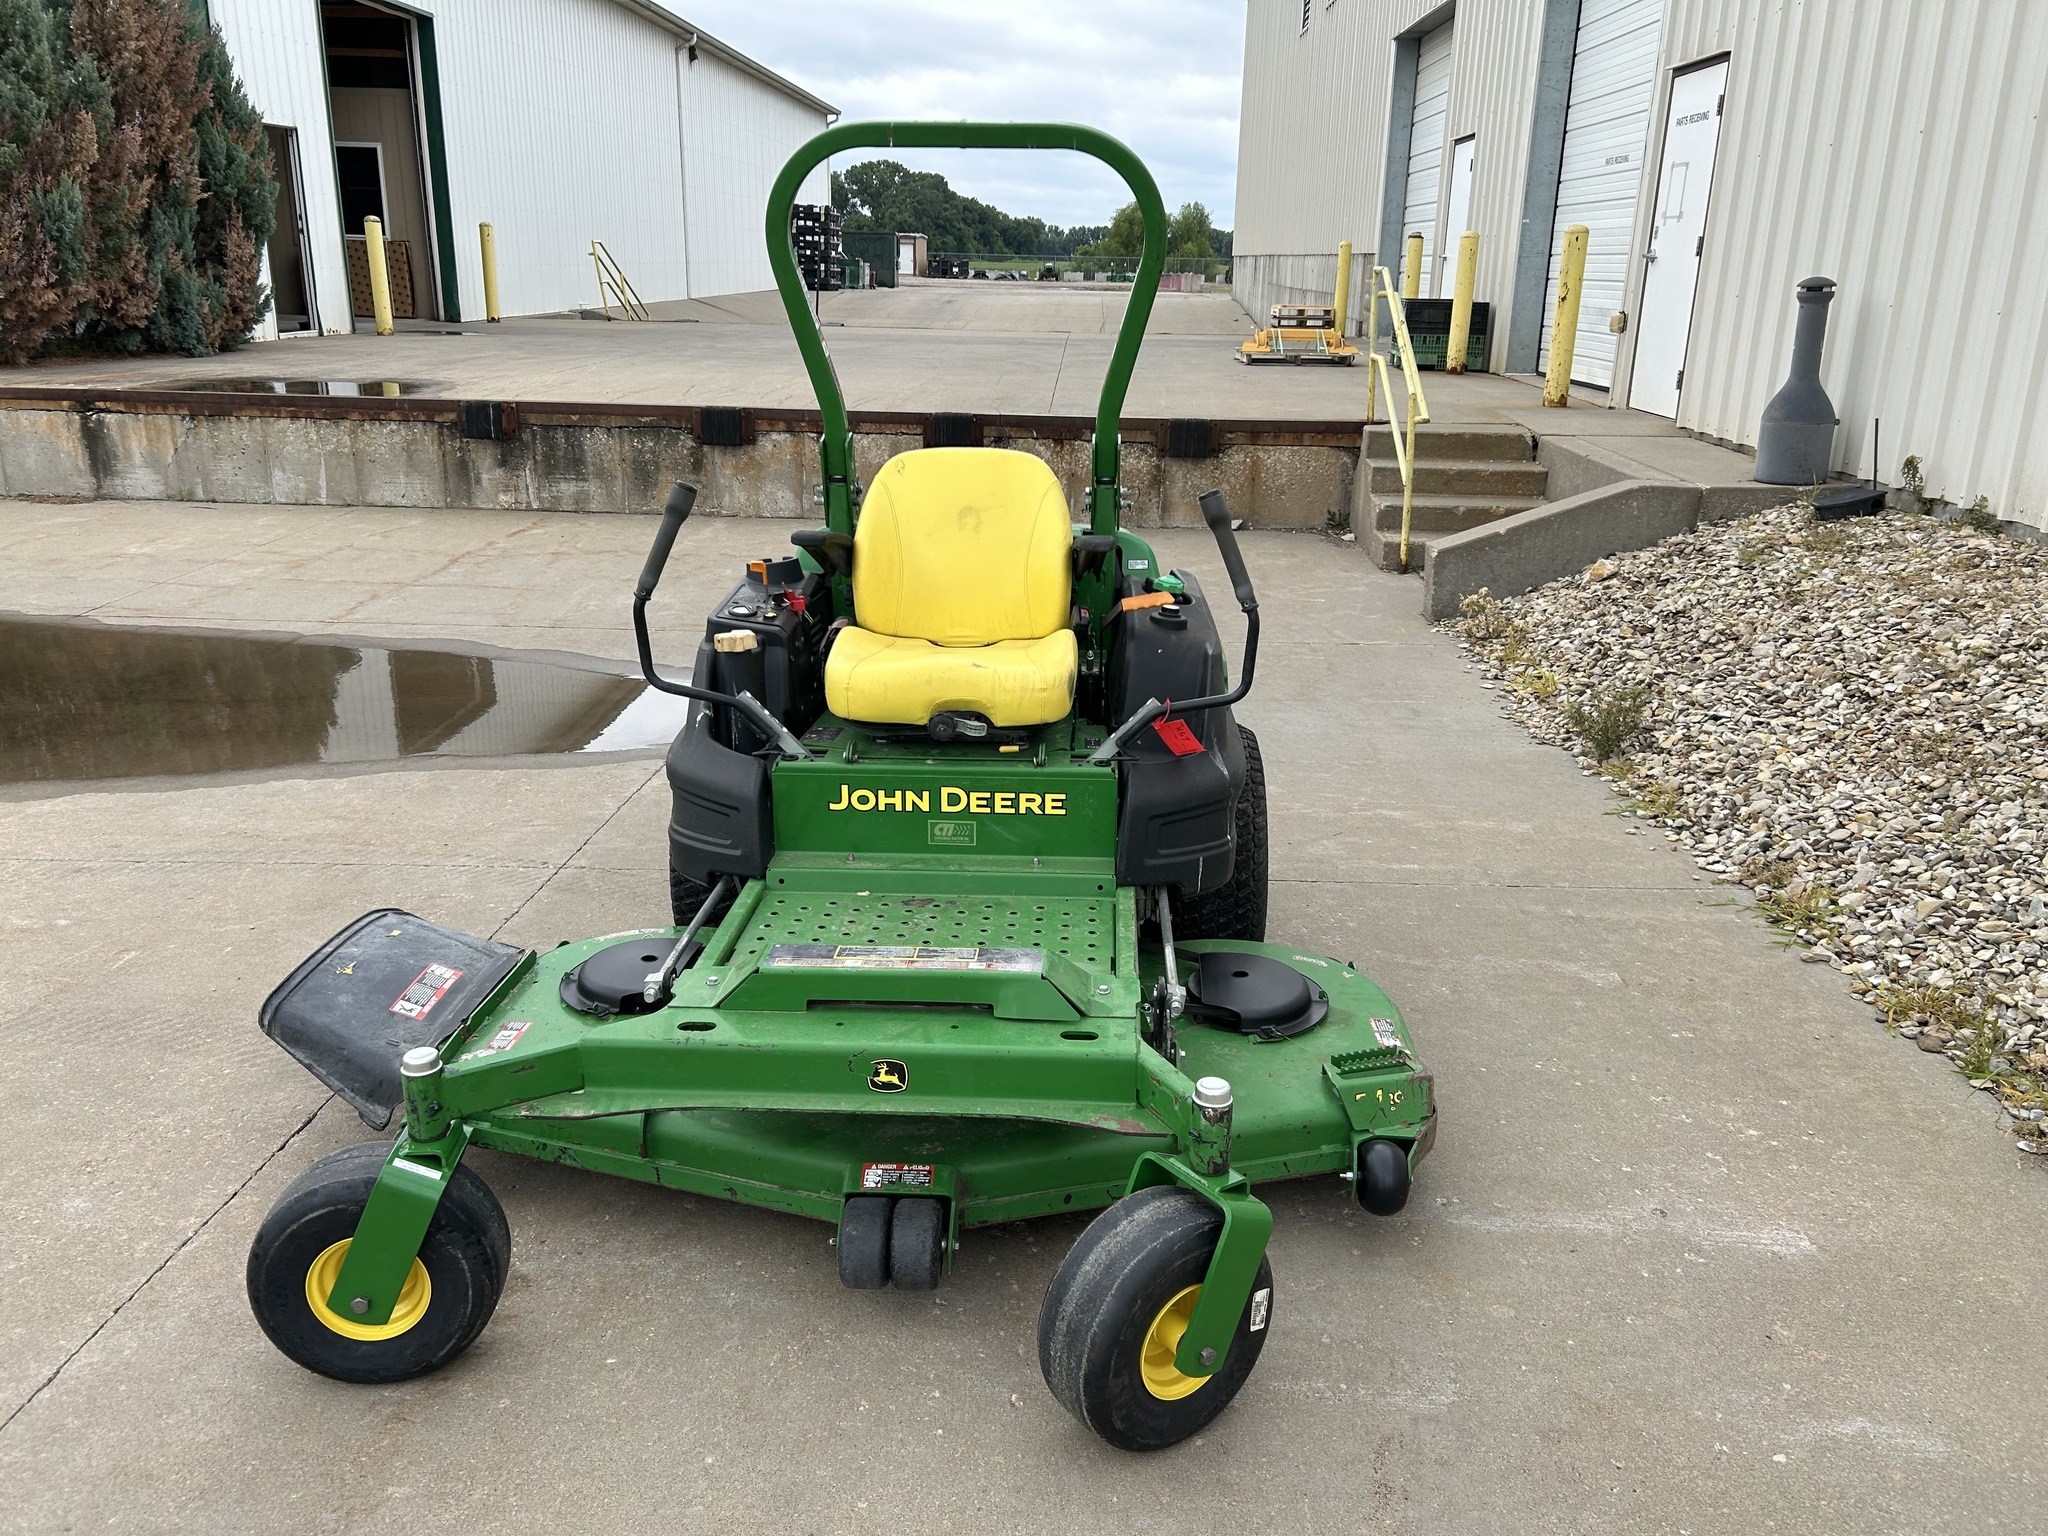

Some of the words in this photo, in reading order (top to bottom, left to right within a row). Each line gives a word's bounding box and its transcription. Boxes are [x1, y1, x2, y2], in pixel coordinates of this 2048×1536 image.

[1676, 115, 1689, 127] PARTS
[1689, 110, 1710, 124] RECEIVING
[1605, 156, 1615, 165] PARTS
[1615, 154, 1630, 164] RECEIVING
[828, 784, 931, 812] JOHN
[940, 786, 1068, 815] DEERE
[934, 823, 955, 836] CTI
